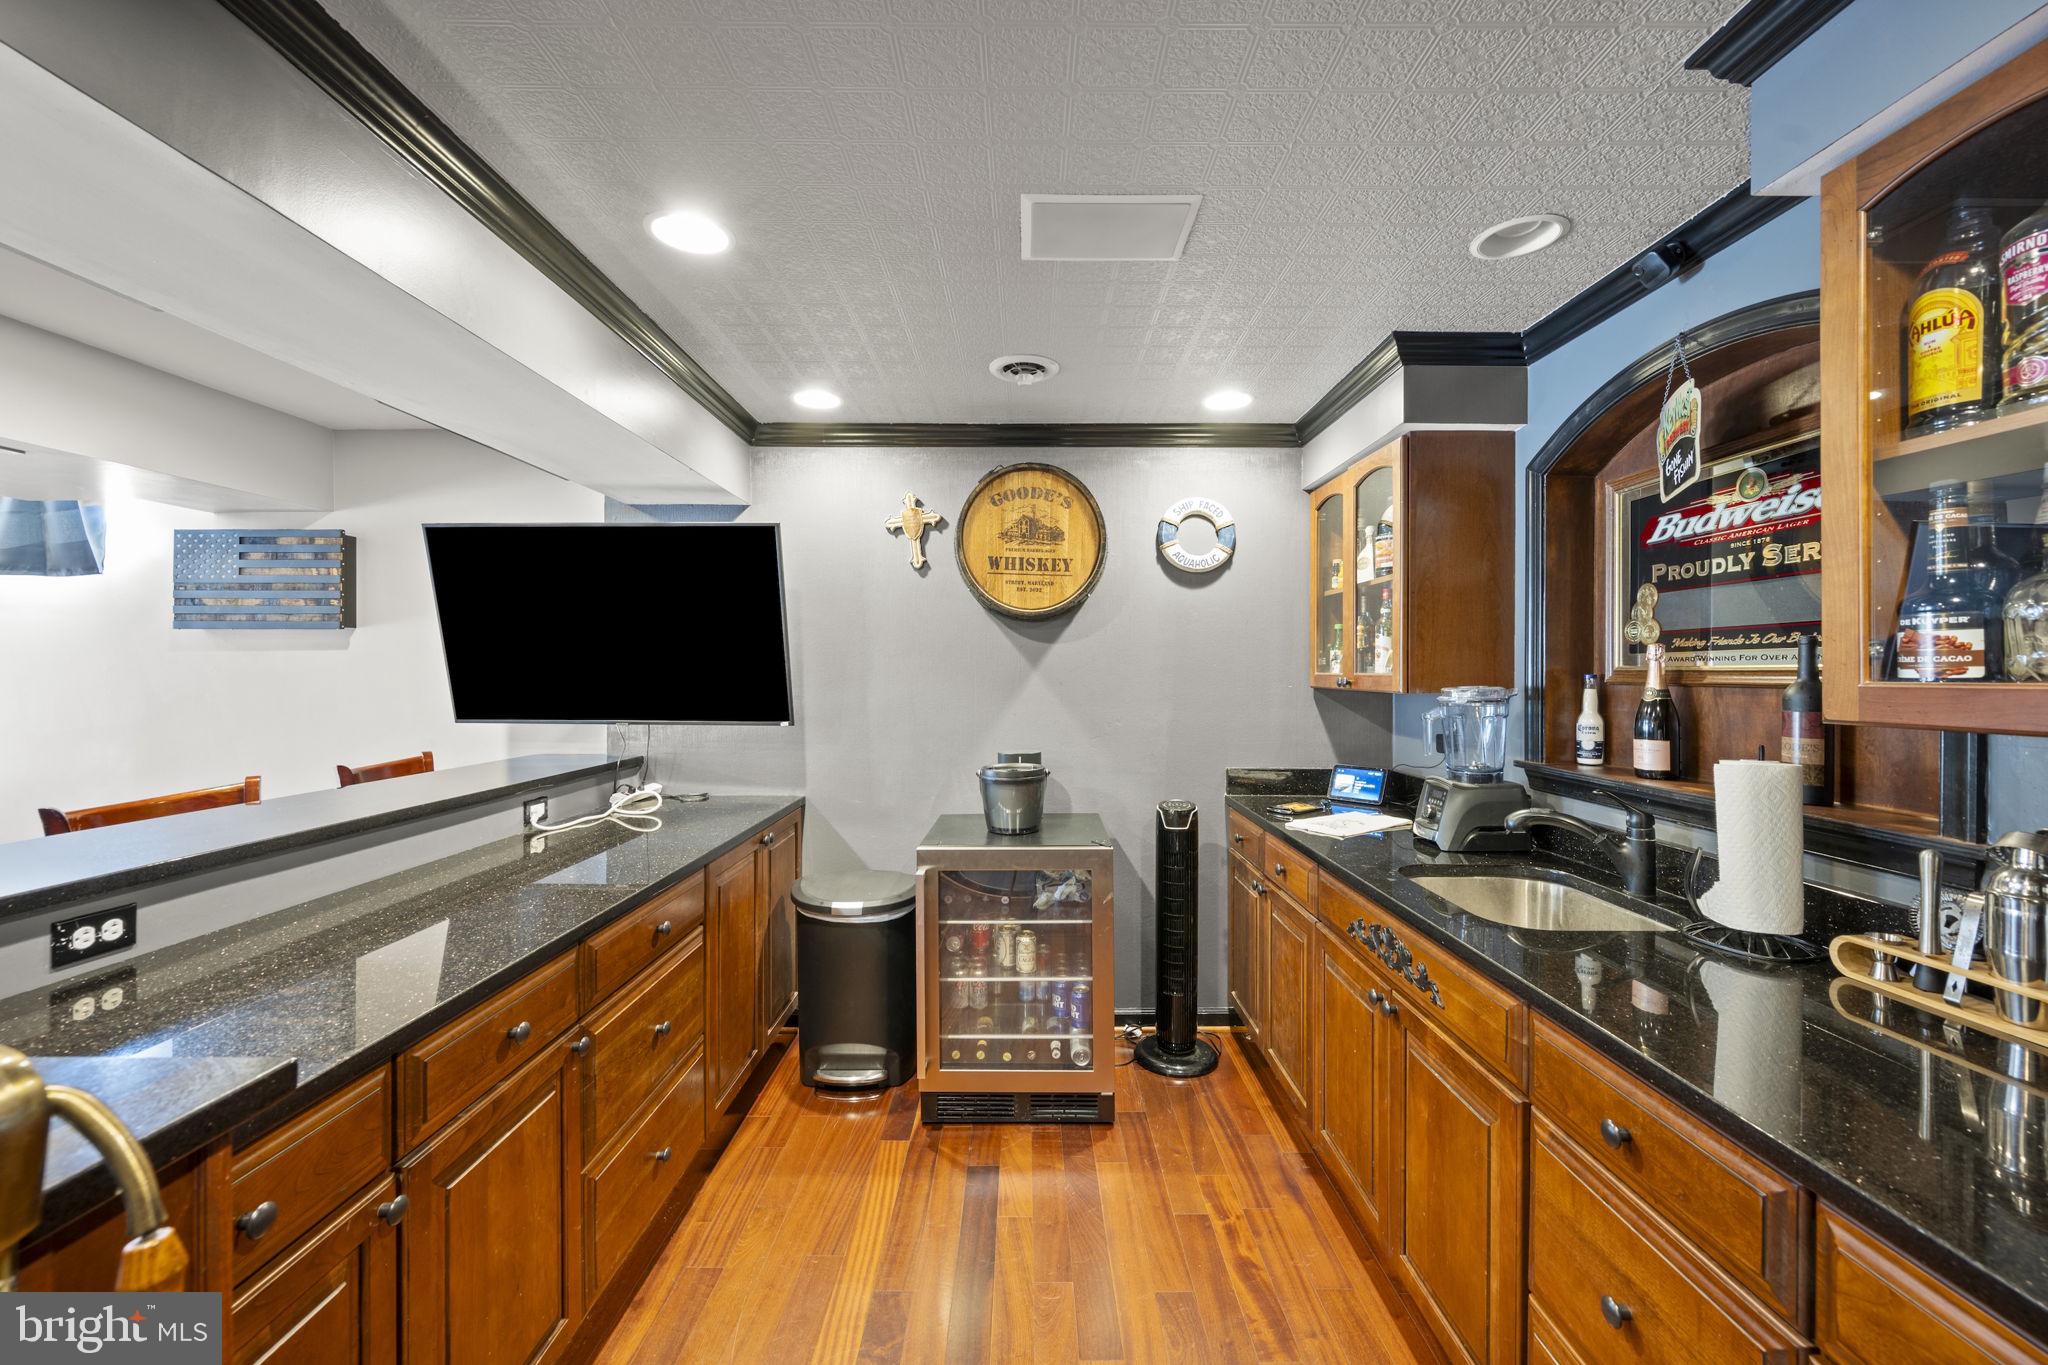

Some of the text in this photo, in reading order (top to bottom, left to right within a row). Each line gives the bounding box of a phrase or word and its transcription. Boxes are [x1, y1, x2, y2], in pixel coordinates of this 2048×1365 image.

[1999, 233, 2048, 266] SMIRNO
[1665, 449, 1682, 477] GONE
[990, 486, 1073, 510] GOODE'S
[1172, 500, 1224, 518] SHIP FACED
[1693, 519, 1810, 546] CLASSIC AMERICAN LAGER
[1730, 539, 1751, 549] SINCE
[987, 556, 1074, 572] WHISKEY
[1172, 551, 1220, 568] AQUAHOLIC
[1651, 541, 1822, 583] PROUDLY SER
[1760, 653, 1788, 661] OVER
